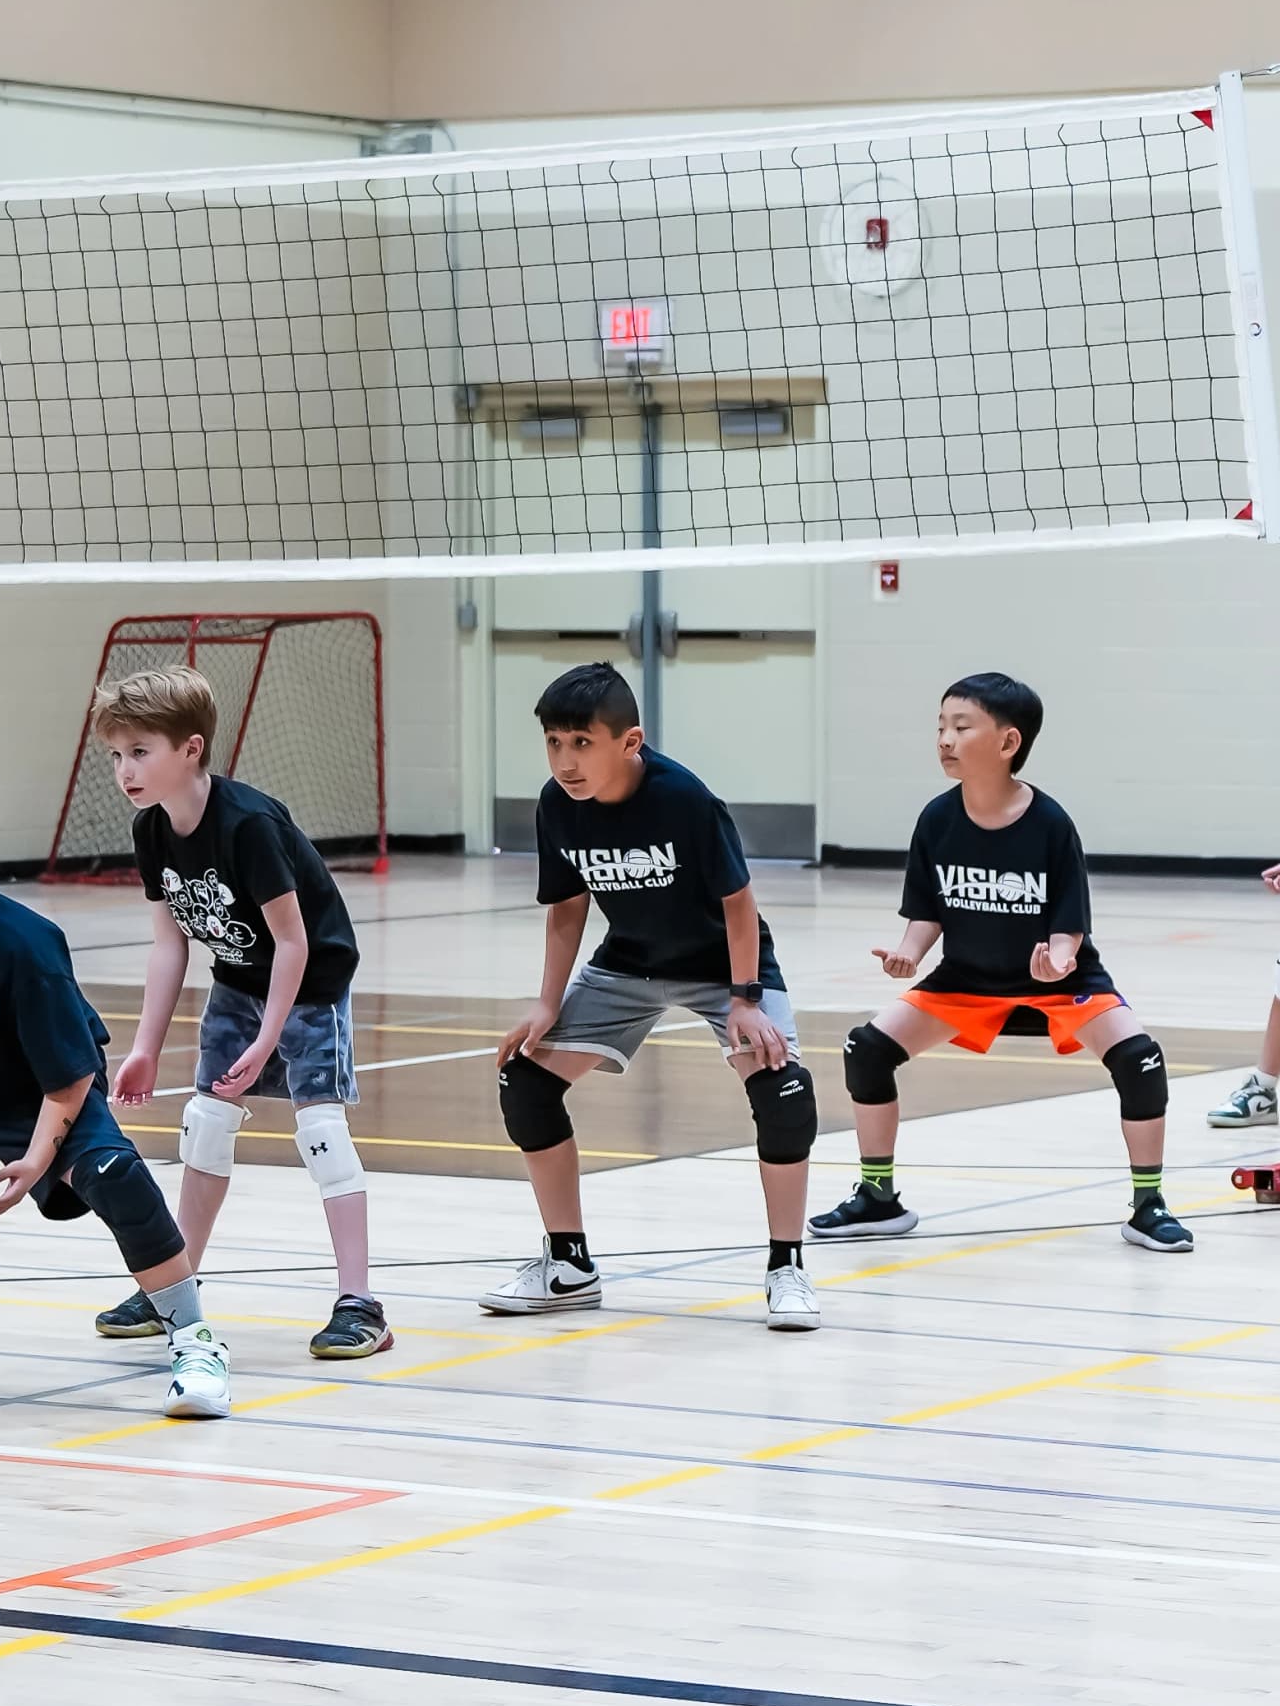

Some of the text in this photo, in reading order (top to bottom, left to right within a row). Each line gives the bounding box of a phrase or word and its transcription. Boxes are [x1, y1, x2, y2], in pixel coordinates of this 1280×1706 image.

[610, 308, 651, 343] EXIT
[645, 875, 674, 888] CLUB
[936, 864, 1047, 903] VISION
[945, 897, 1041, 914] VOLLEYBALL CLUB
